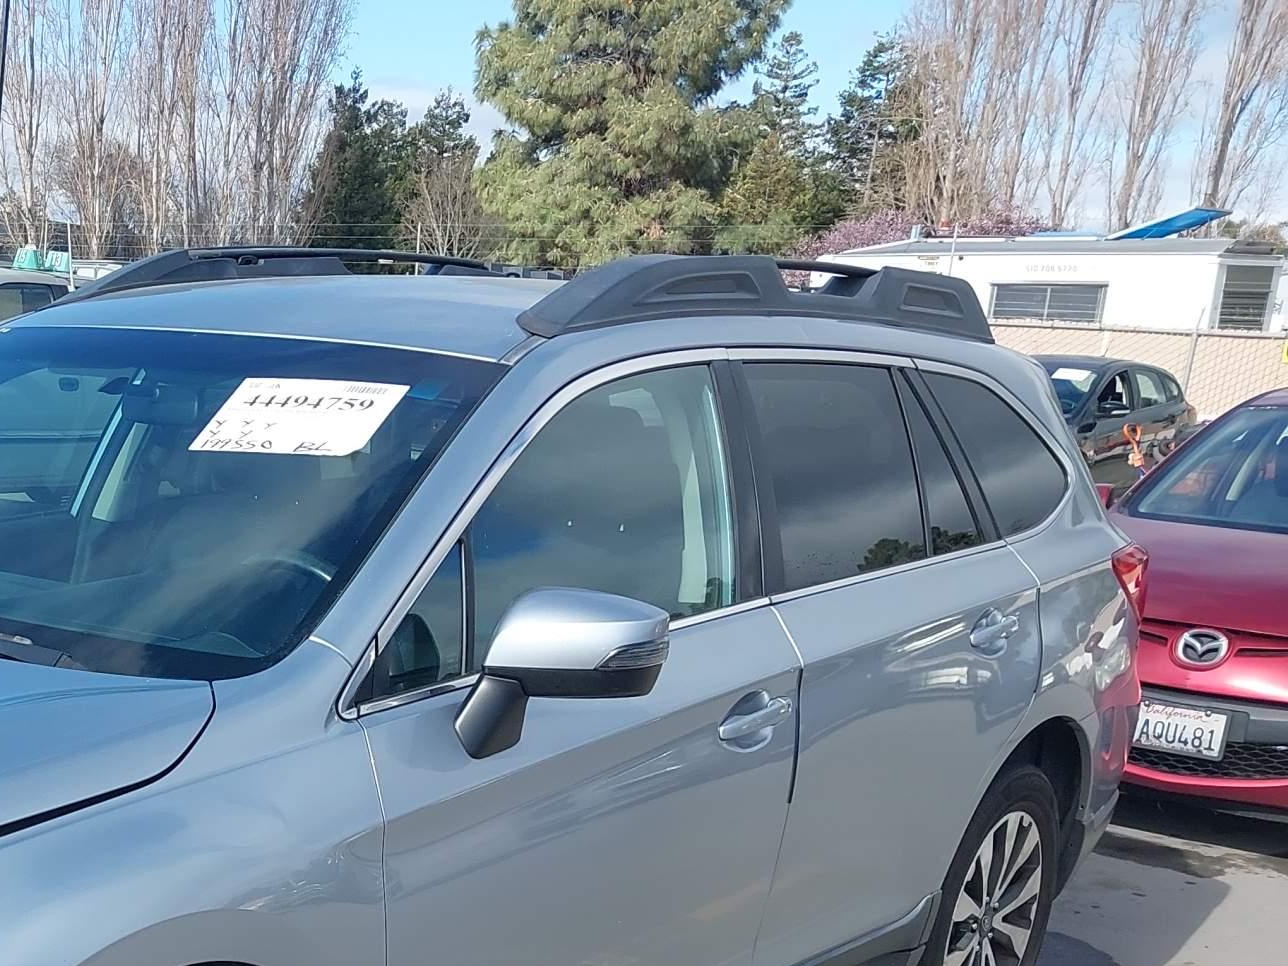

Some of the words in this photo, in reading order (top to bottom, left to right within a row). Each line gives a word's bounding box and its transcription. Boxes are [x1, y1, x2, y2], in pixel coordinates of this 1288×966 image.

[243, 394, 374, 410] 44494759
[1145, 703, 1208, 722] California
[1138, 718, 1215, 752] AQU481
